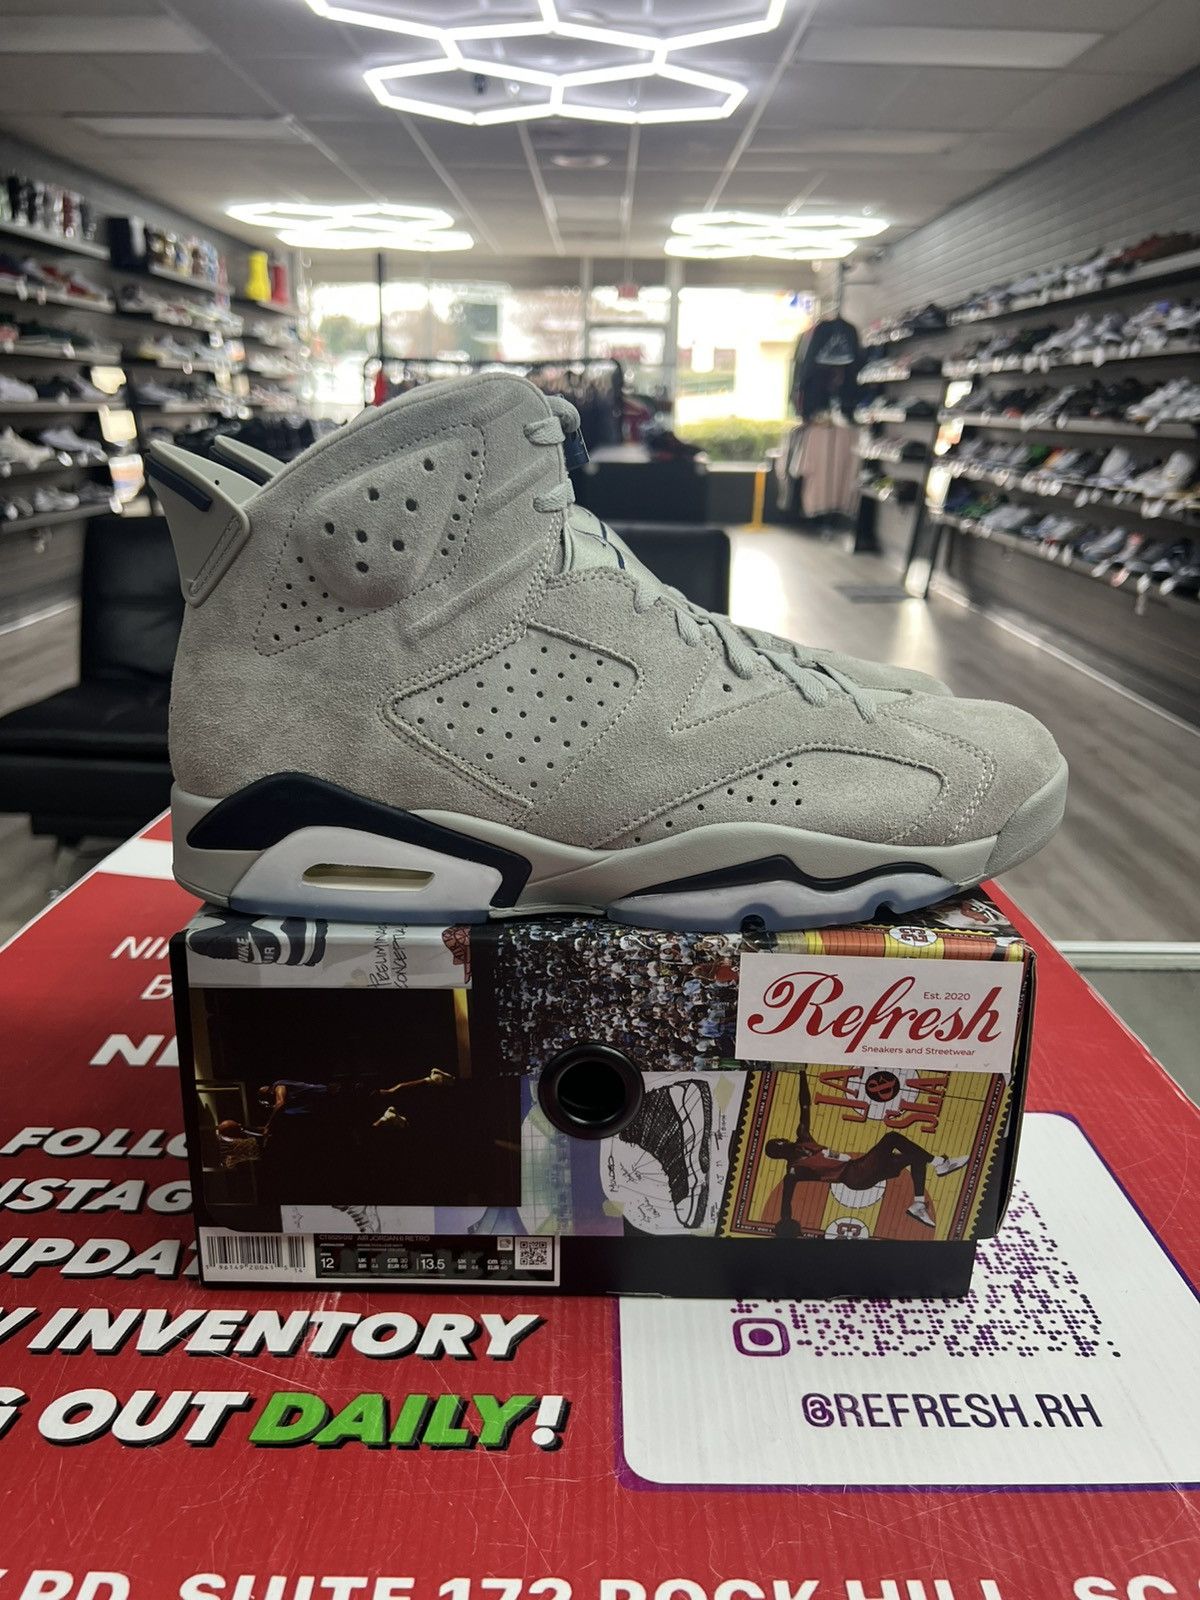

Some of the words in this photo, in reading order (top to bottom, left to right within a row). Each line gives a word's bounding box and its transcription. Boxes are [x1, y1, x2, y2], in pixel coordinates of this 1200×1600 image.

[747, 971, 1003, 1053] Refresh
[923, 991, 941, 1000] Est.
[945, 992, 970, 1001] 2020
[861, 1045, 903, 1054] Sneakers
[906, 1046, 922, 1055] and
[925, 1047, 975, 1056] Streetwear
[883, 1070, 950, 1134] SLA
[320, 1257, 335, 1269] 12
[420, 1258, 446, 1270] 13.5
[27, 1308, 542, 1357] INVENTORY
[37, 1388, 249, 1442] OUT
[248, 1392, 566, 1448] DAILY!
[801, 1392, 1103, 1429] @REFRESH.RH
